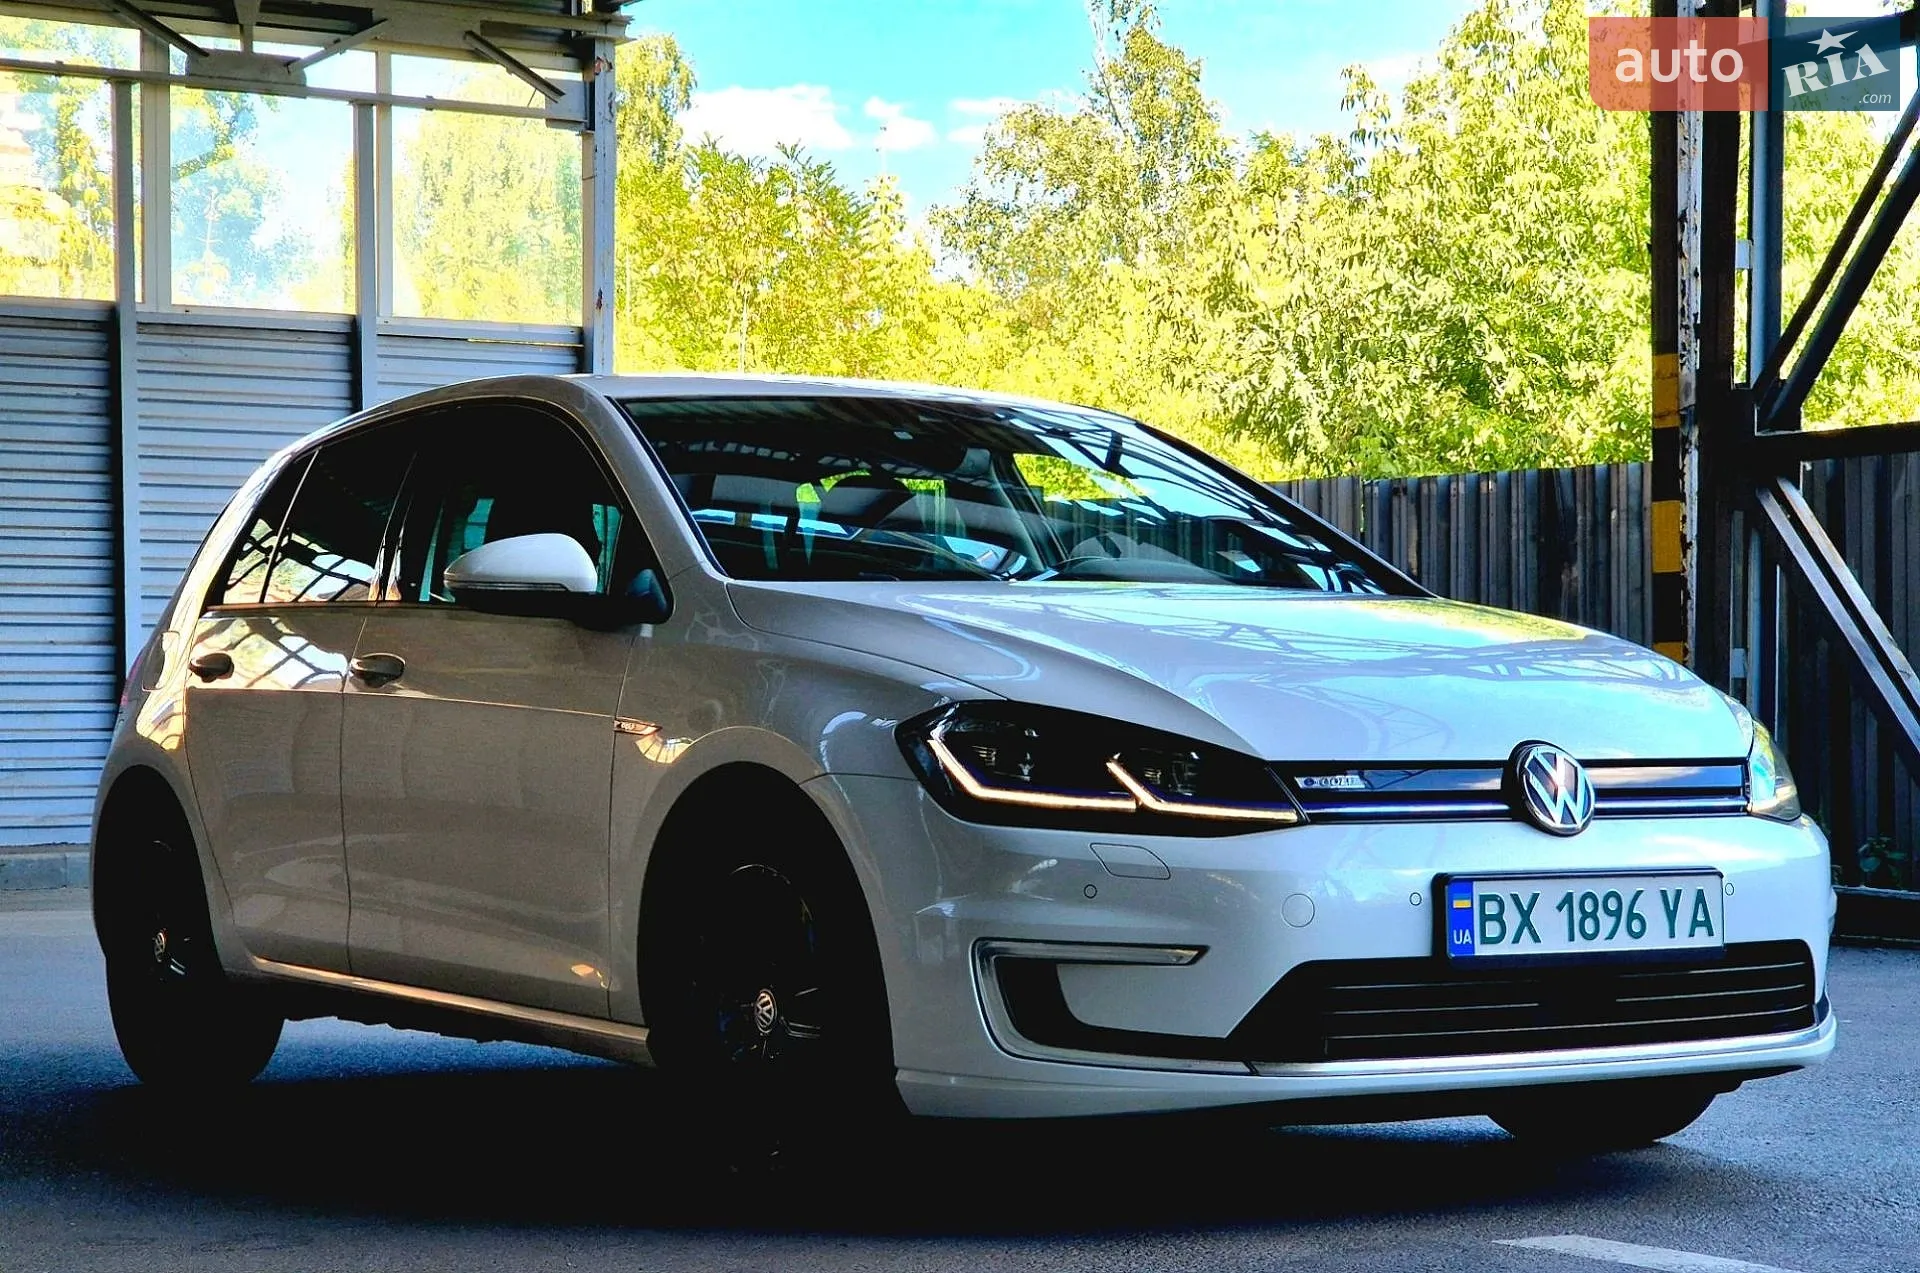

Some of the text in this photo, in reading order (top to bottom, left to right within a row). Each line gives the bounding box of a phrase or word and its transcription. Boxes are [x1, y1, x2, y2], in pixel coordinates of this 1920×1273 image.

[1525, 747, 1594, 828] VW
[1453, 929, 1472, 945] UA
[1479, 888, 1715, 945] BX 1896 YA
